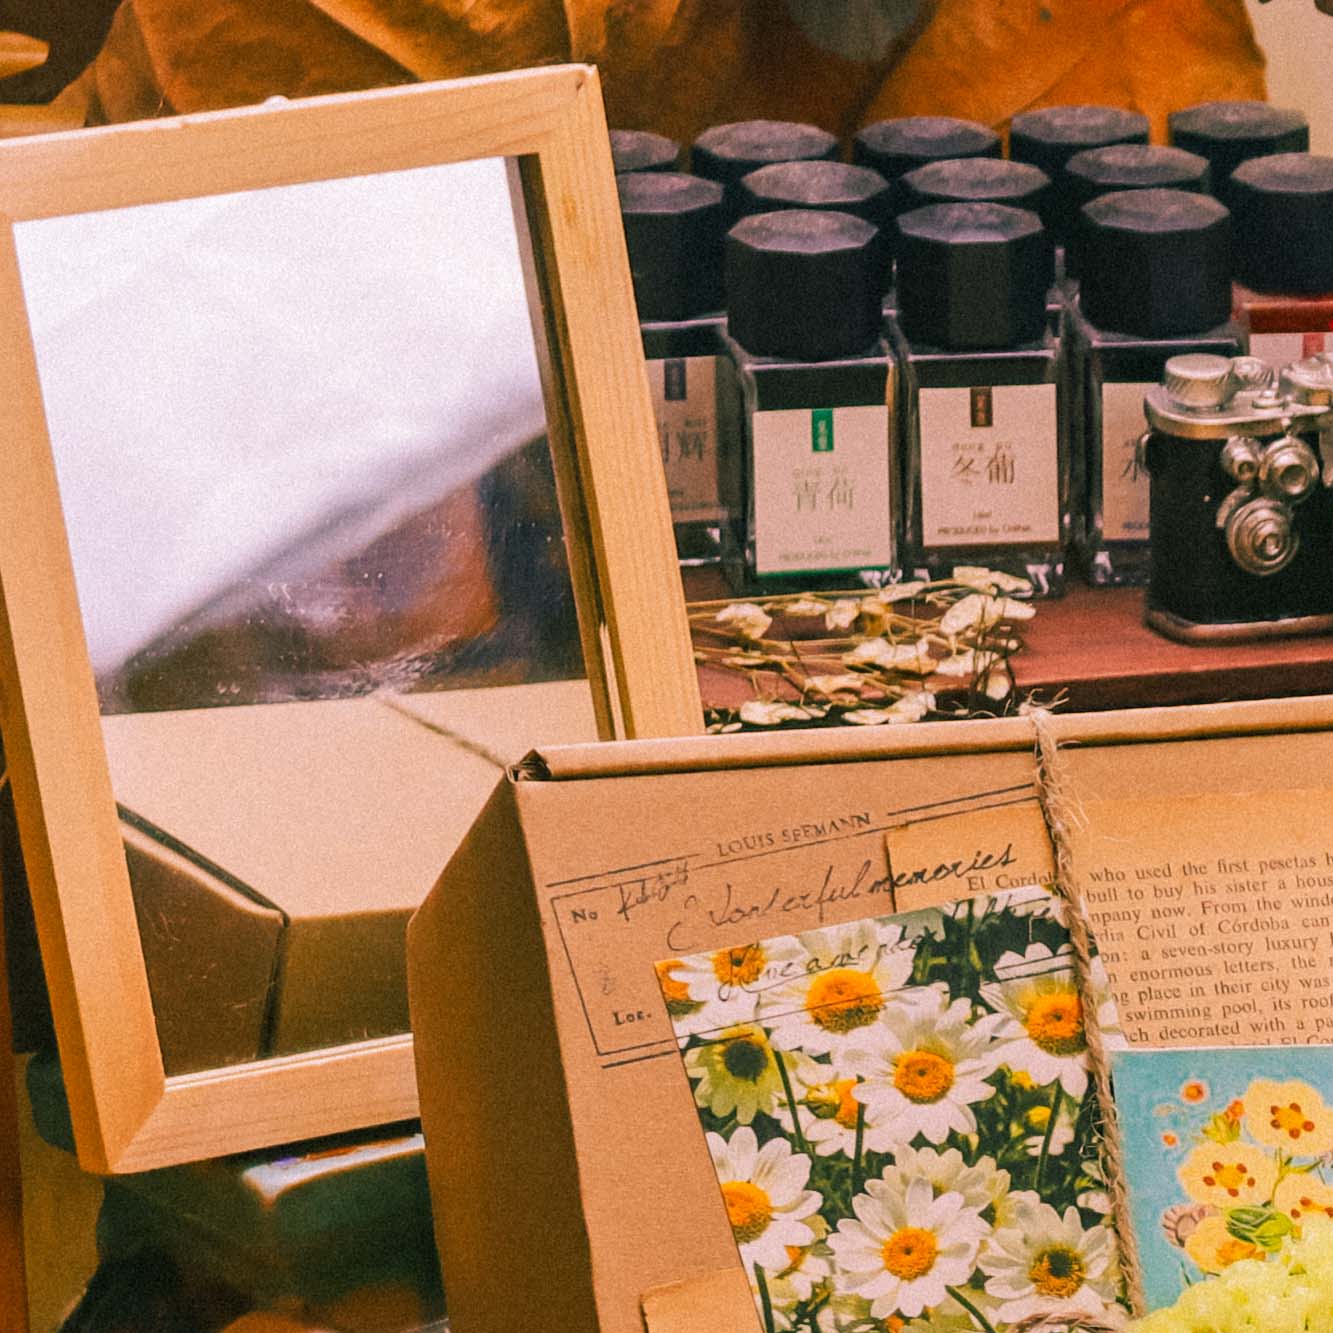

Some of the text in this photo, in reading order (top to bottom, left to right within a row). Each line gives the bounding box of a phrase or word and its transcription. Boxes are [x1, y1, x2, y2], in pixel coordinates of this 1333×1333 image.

[717, 832, 774, 857] LOUIS
[1089, 867, 1126, 882] who
[1135, 864, 1172, 879] used
[1218, 859, 1249, 874] first
[1258, 854, 1316, 875] pesetas
[1086, 887, 1118, 903] bull
[1225, 879, 1267, 893] sister
[571, 908, 598, 923] No
[1137, 917, 1289, 941] Civil Córdoba
[1161, 941, 1253, 958] seven-story
[1265, 936, 1319, 951] luxury
[1130, 959, 1280, 982] enormous letters,
[1125, 1002, 1262, 1021] swimming pool,
[1159, 1023, 1240, 1041] decorated
[1250, 1018, 1285, 1032] with
